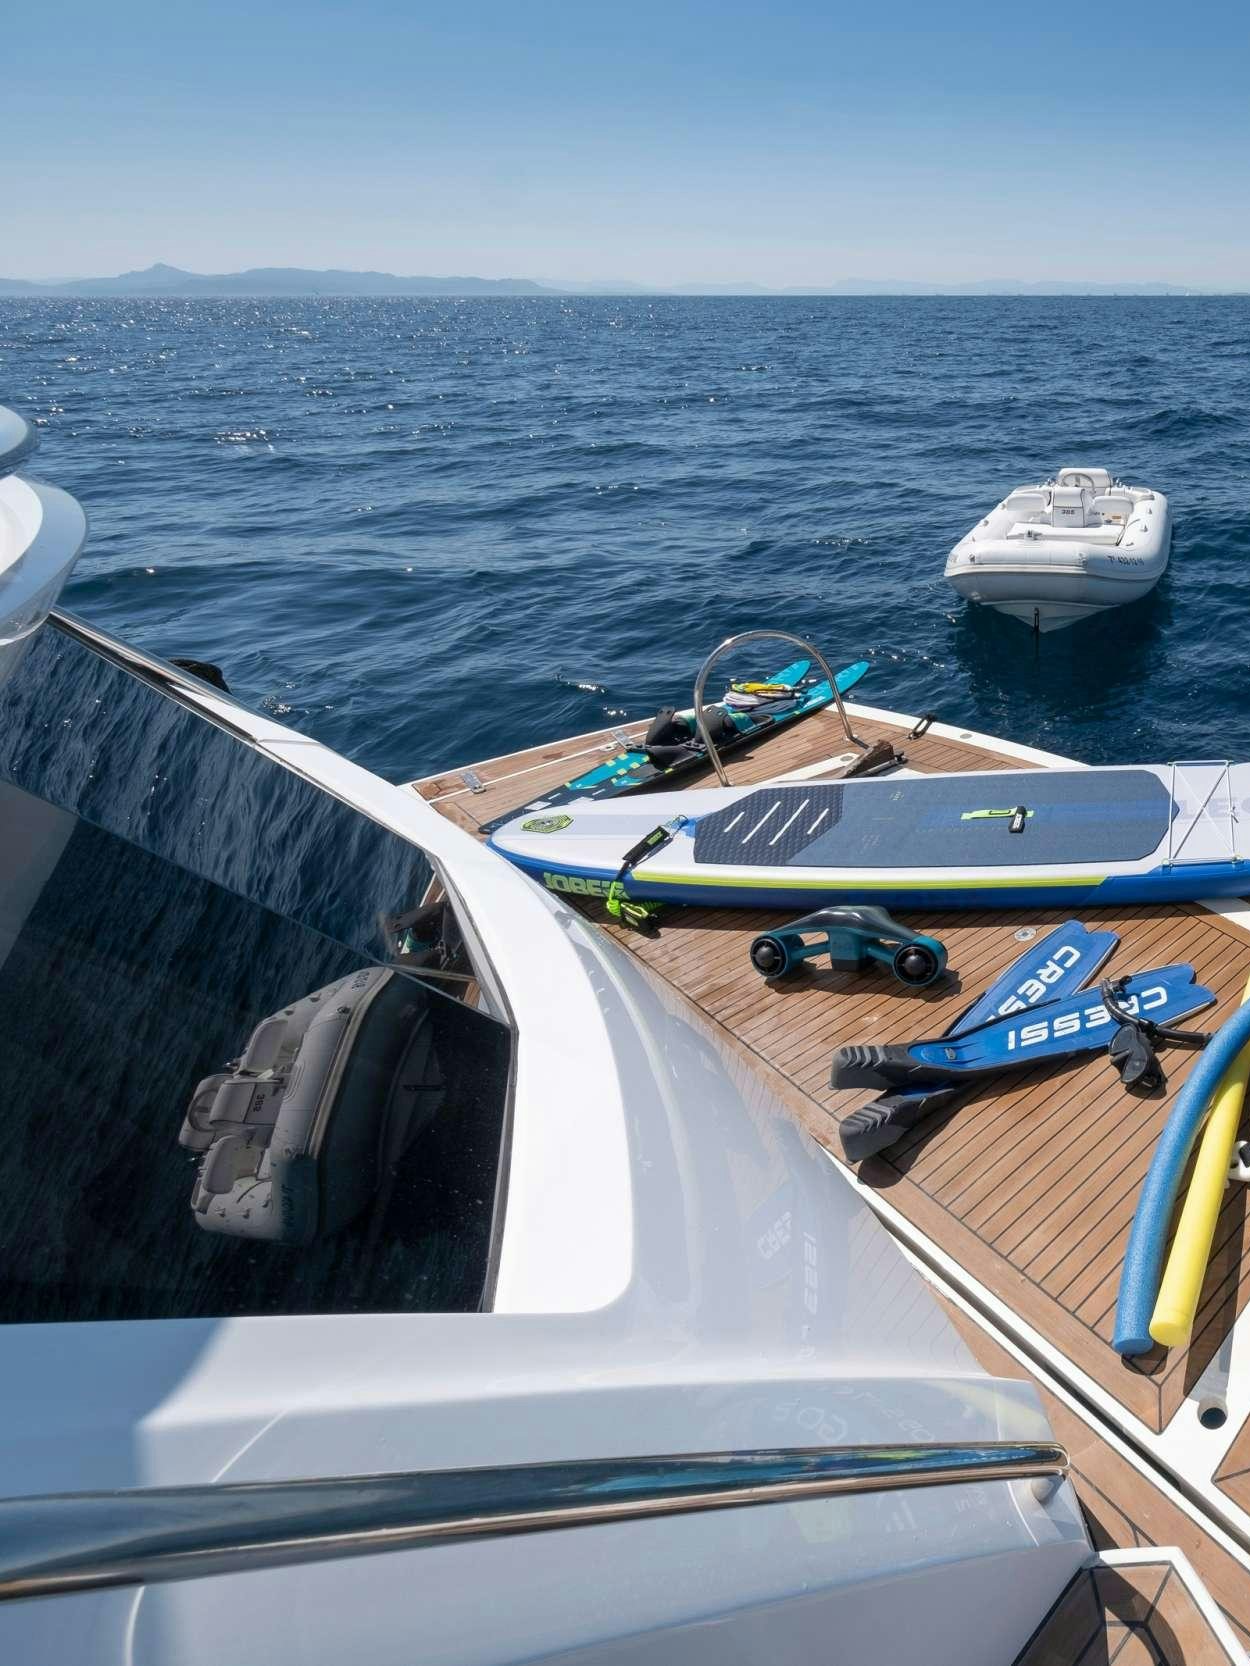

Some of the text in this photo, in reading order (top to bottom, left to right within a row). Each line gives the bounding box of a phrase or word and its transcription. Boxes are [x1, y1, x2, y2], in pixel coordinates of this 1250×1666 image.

[543, 871, 603, 897] JOBE
[987, 945, 1081, 1022] CRES
[1007, 986, 1168, 1050] CRESSI
